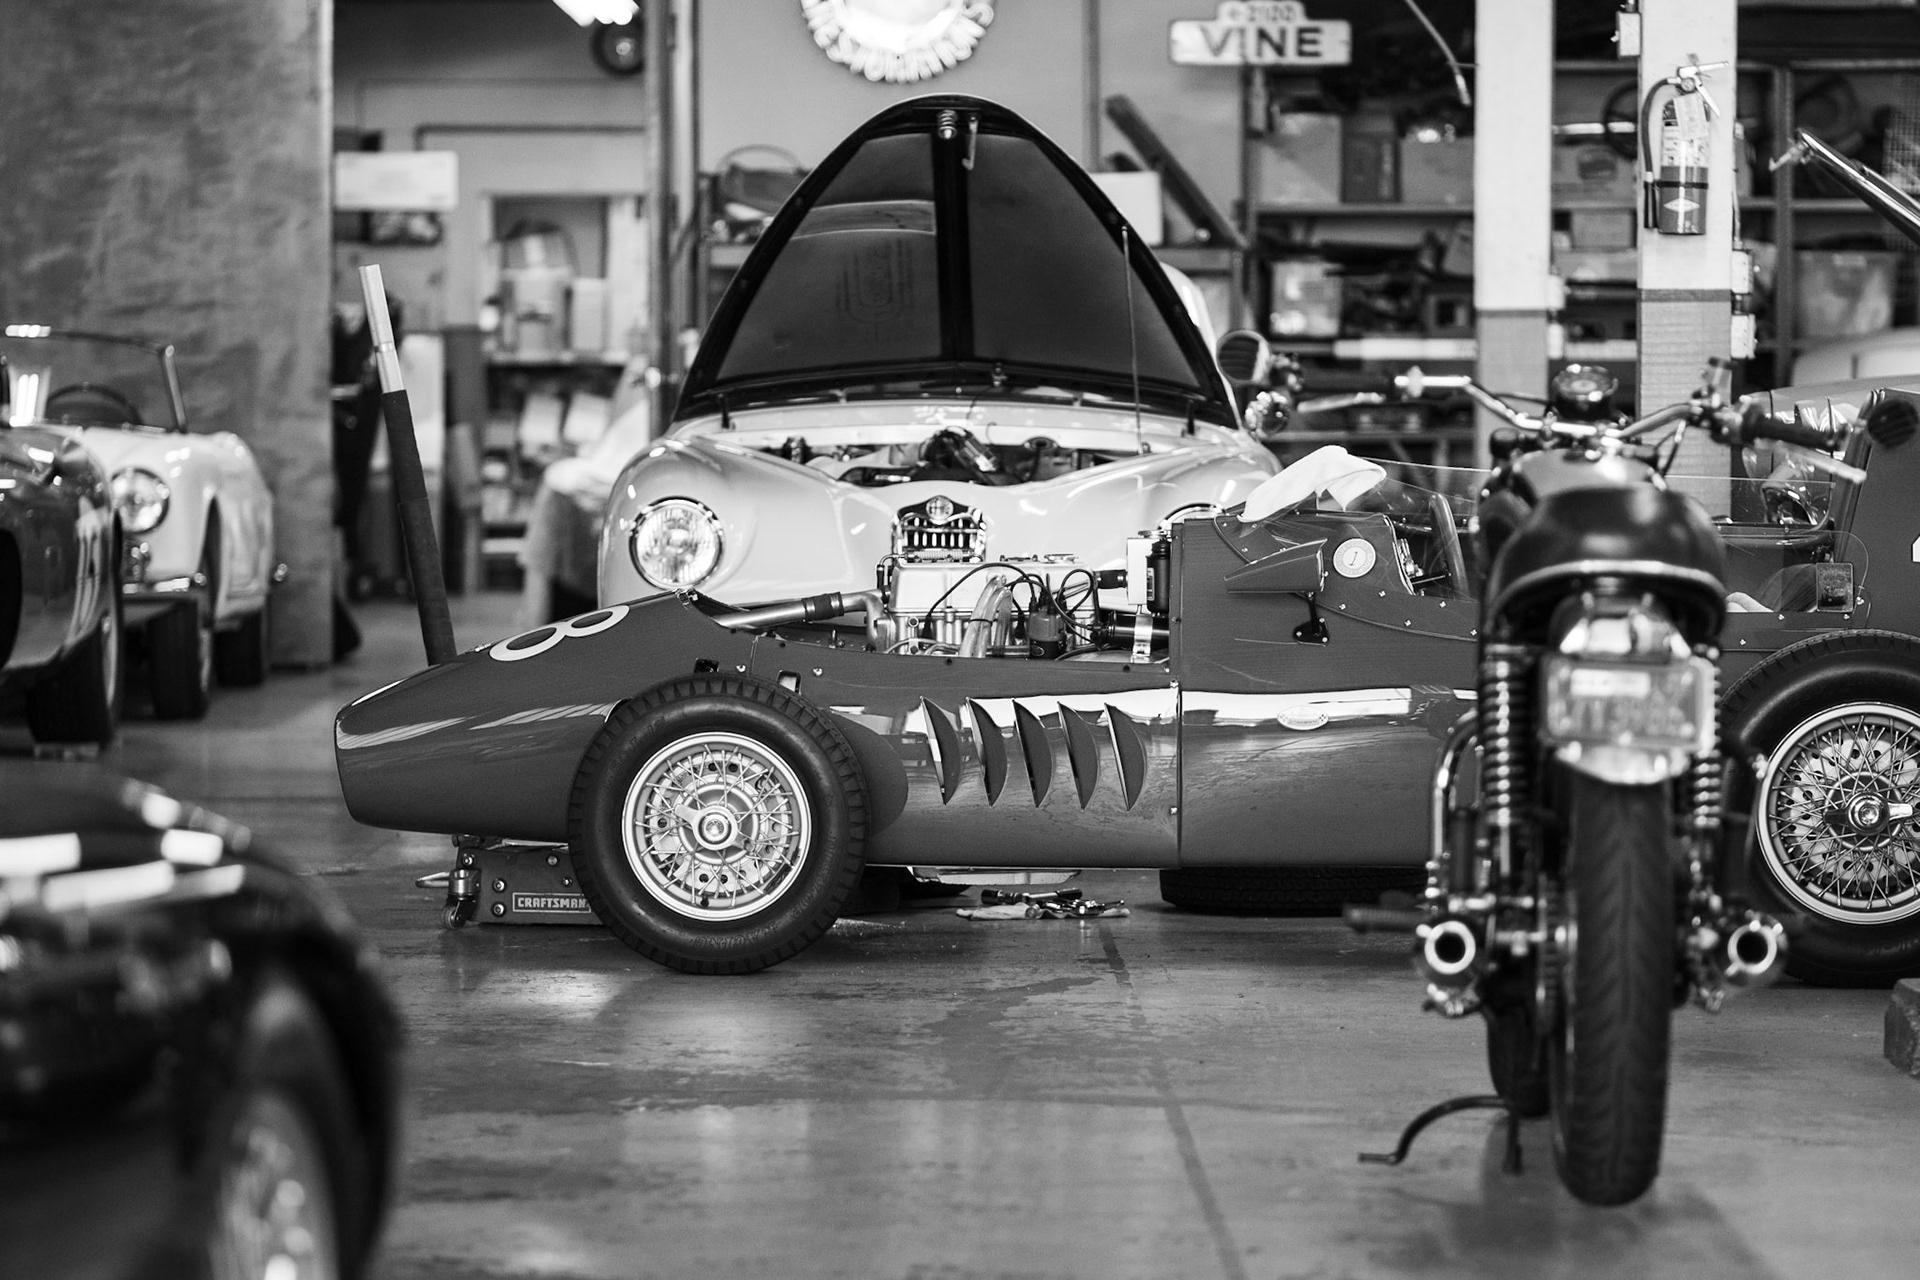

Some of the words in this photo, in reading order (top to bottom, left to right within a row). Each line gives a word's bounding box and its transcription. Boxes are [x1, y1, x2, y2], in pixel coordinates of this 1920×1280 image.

[1198, 26, 1322, 57] VINE
[489, 604, 630, 662] 8
[517, 897, 586, 909] CRAFTSMAN
